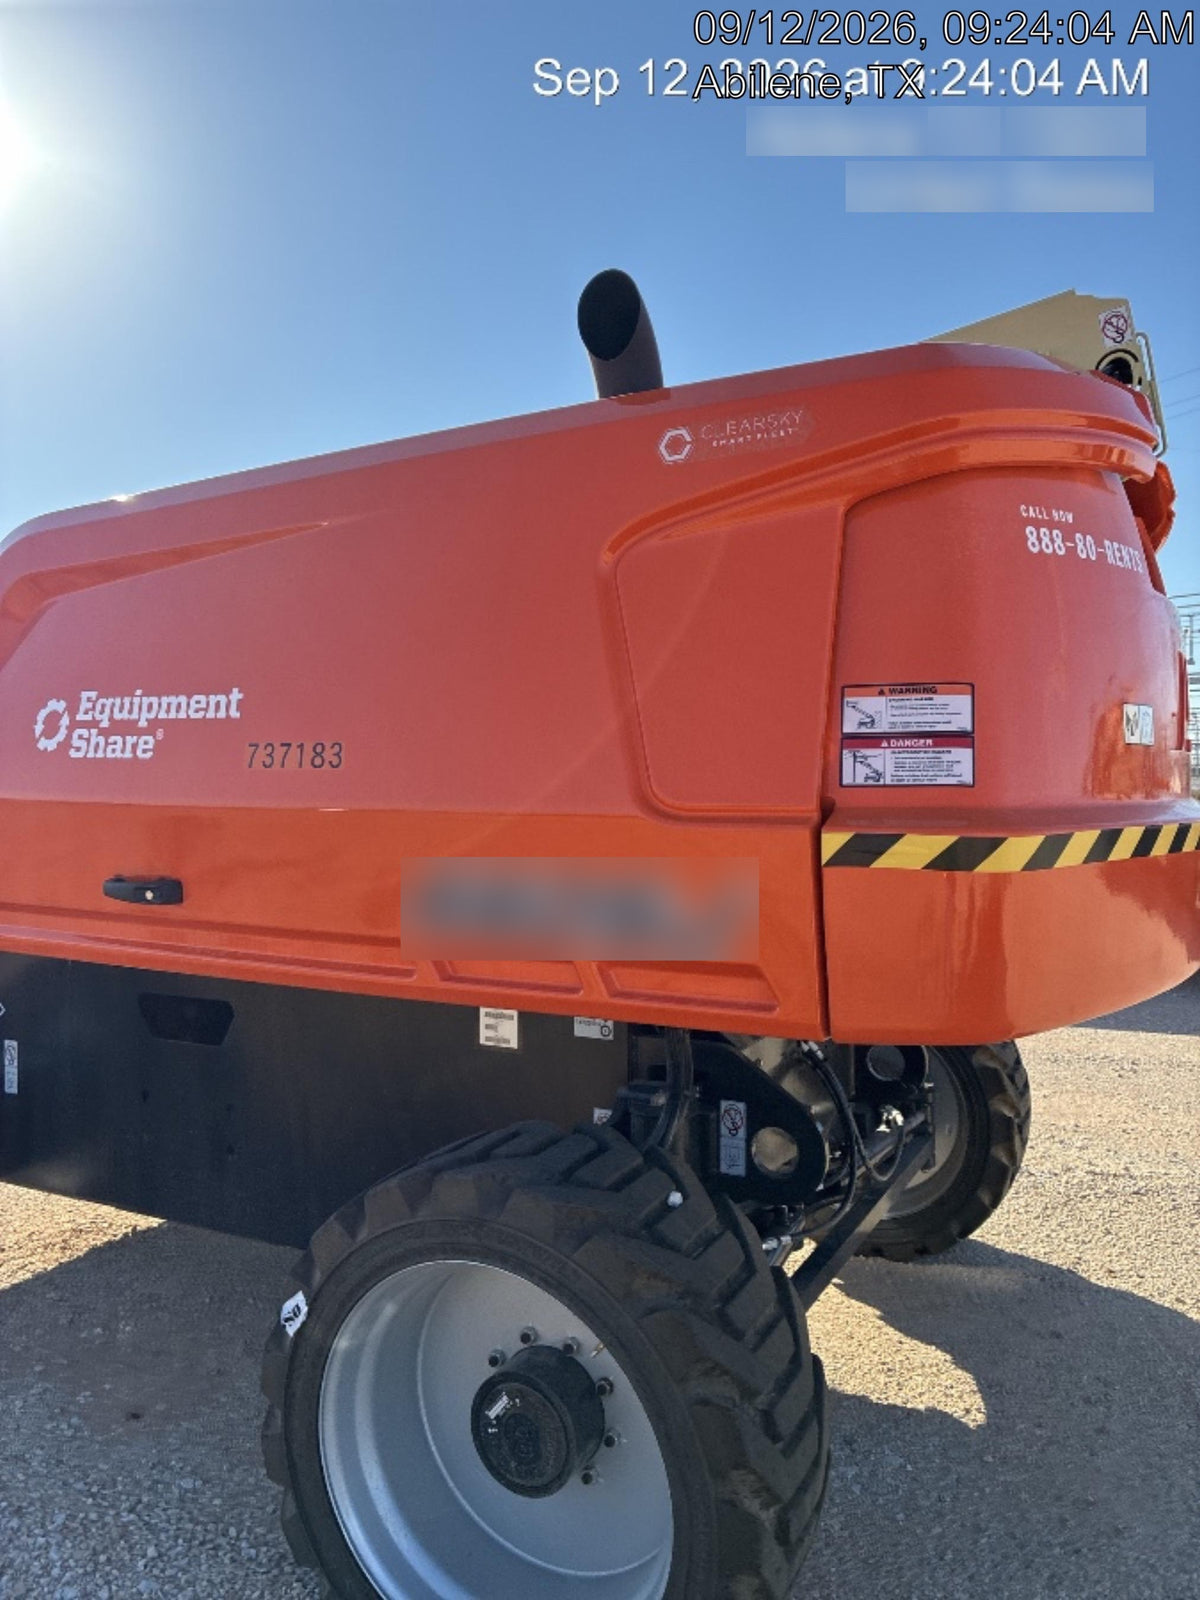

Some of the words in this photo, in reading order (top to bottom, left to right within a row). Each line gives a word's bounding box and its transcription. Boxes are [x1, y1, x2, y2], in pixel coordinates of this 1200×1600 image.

[1020, 504, 1050, 520] CALL
[1052, 509, 1074, 523] NOW
[889, 686, 938, 695] WARNING
[75, 687, 244, 728] Equipment
[889, 738, 933, 748] DANGER
[247, 742, 343, 769] 737183
